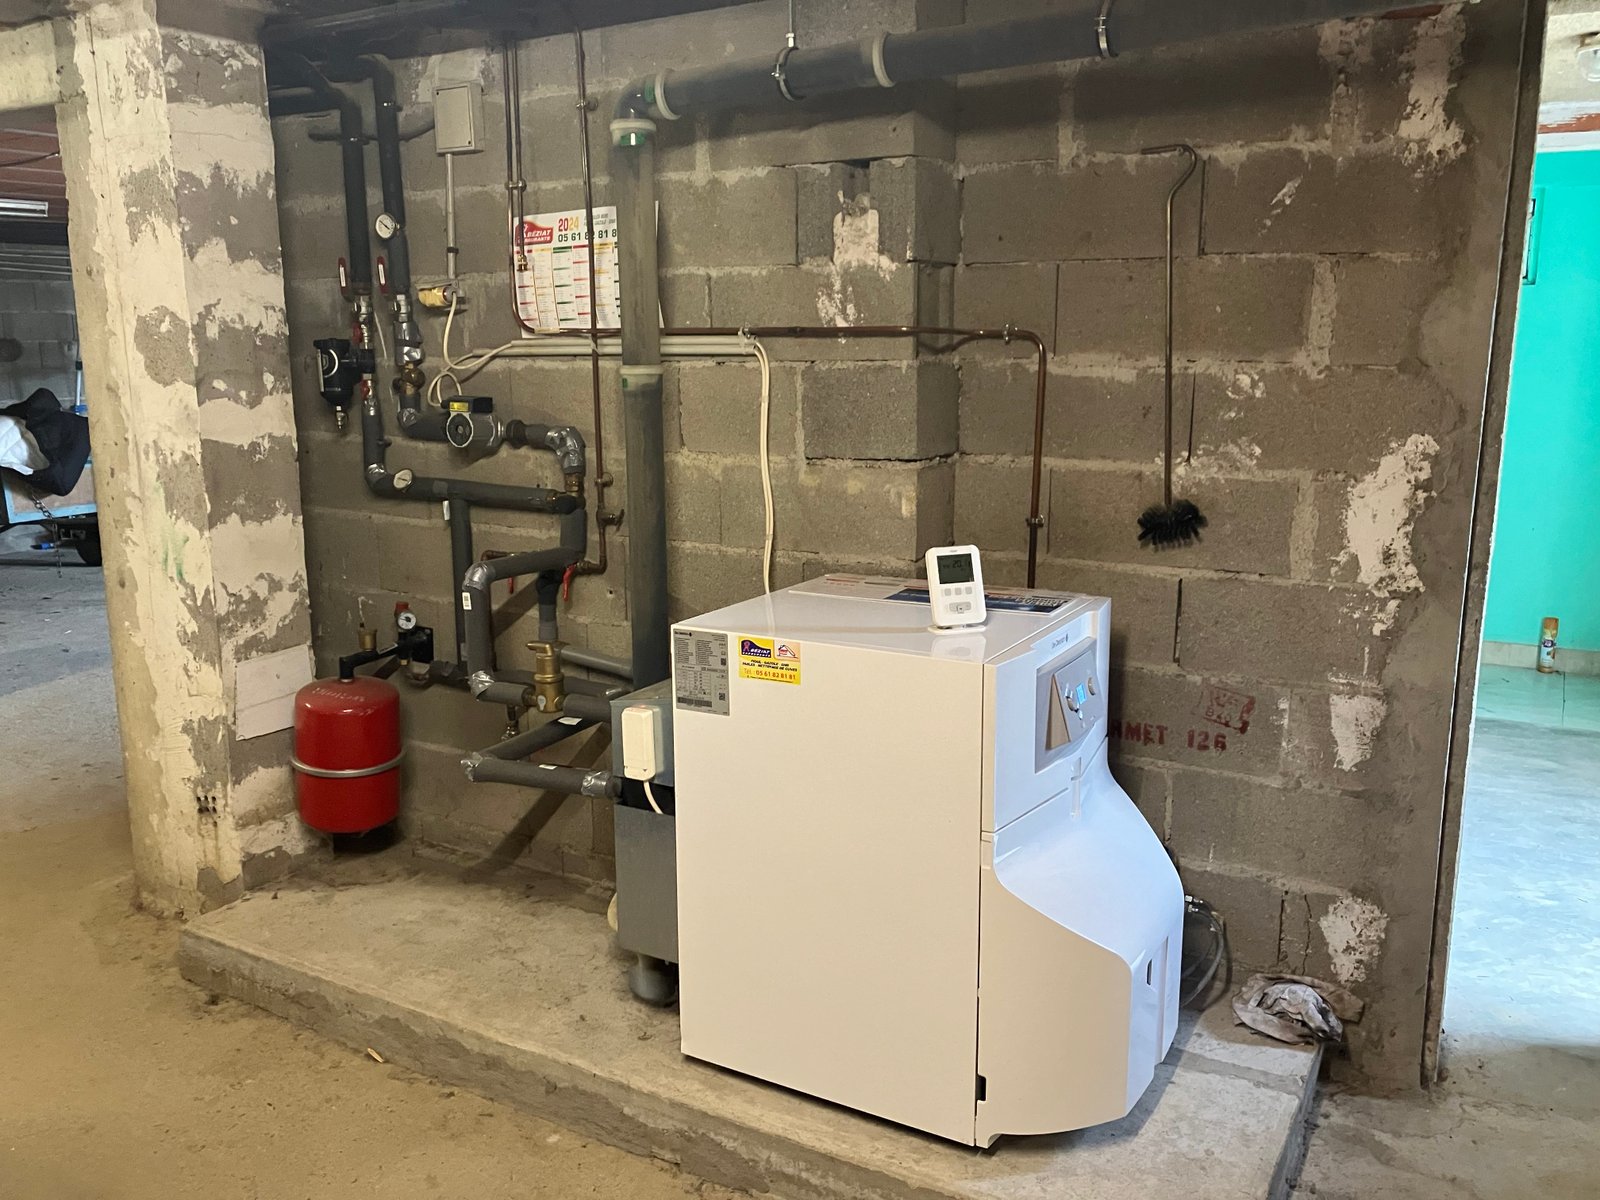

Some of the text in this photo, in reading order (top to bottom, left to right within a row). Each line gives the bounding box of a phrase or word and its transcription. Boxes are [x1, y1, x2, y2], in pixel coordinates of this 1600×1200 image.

[558, 217, 579, 232] 2024
[558, 228, 617, 242] 05 61 8 81 8
[1187, 729, 1227, 751] 126
